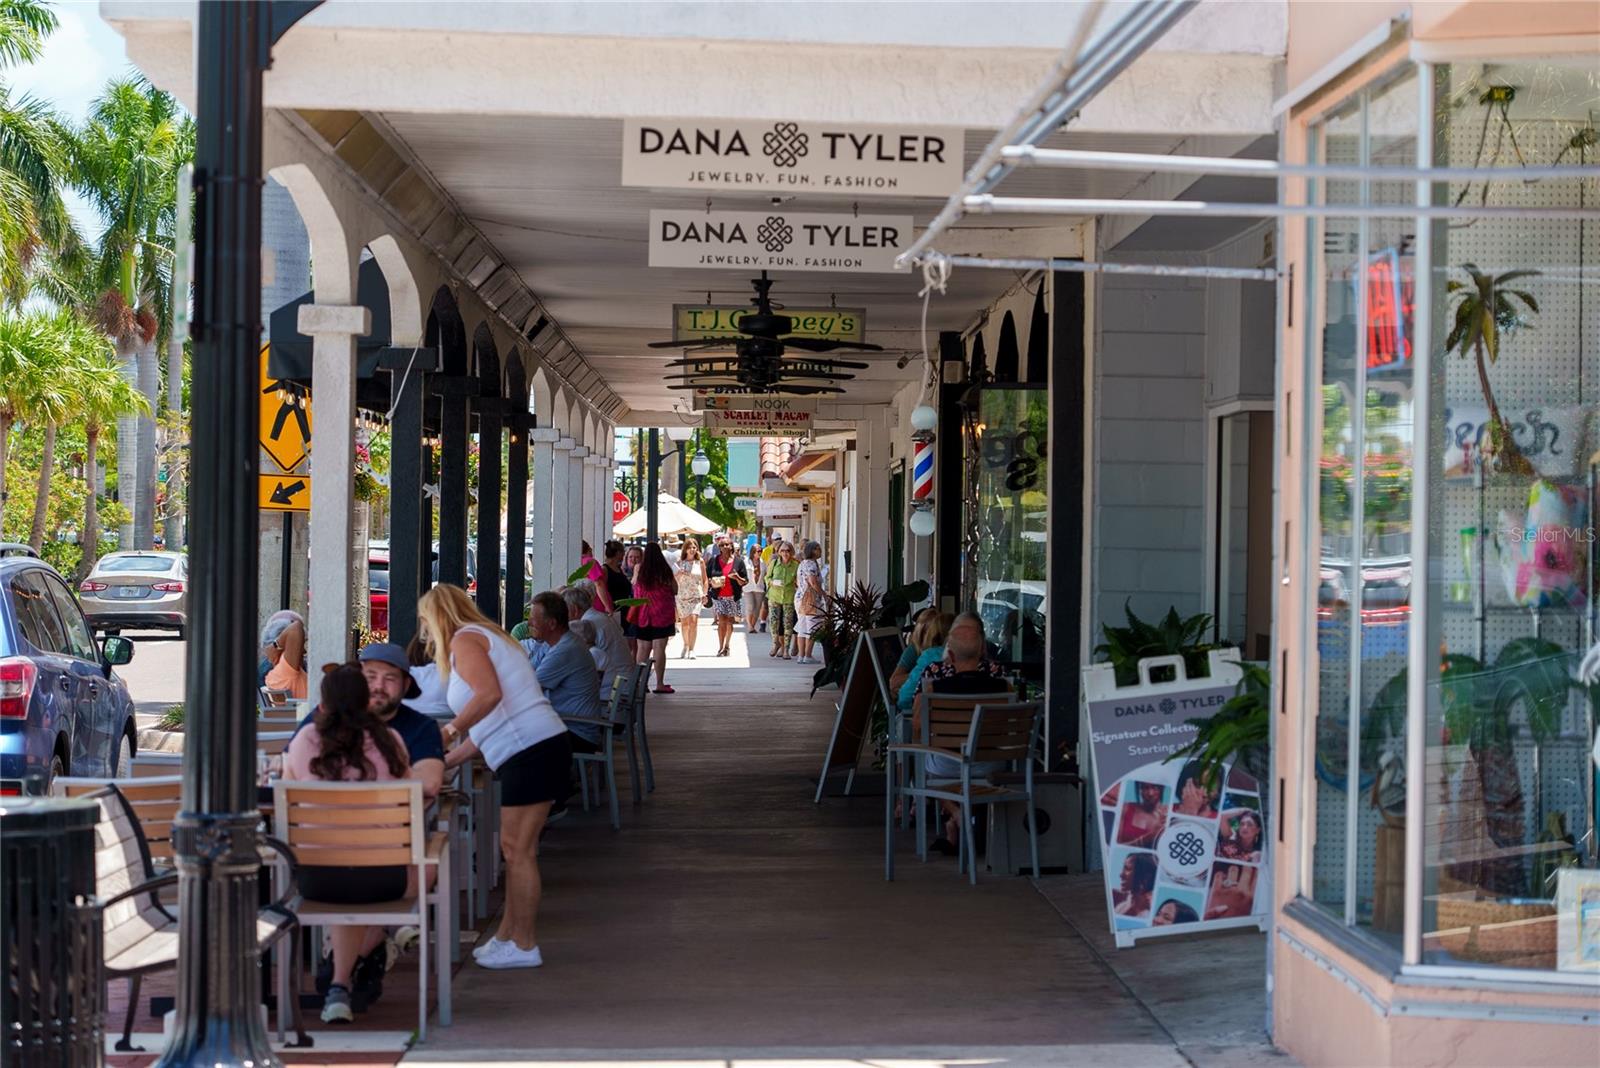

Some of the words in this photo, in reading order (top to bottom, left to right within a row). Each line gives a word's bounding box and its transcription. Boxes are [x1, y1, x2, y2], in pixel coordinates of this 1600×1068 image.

[640, 127, 750, 157] DANA
[822, 132, 946, 163] TYLER
[688, 171, 770, 184] JEWELRY.
[778, 173, 816, 185] FUN.
[824, 175, 898, 188] FASHION
[661, 221, 748, 244] DANA
[803, 225, 899, 248] TYLER
[699, 255, 763, 266] JEWELRY.
[769, 256, 798, 267] FUN.
[805, 257, 863, 268] FASHION
[754, 399, 791, 410] NOOK
[723, 410, 768, 420] SCARLET
[775, 411, 811, 421] MACAW
[783, 429, 806, 437] Shop
[613, 500, 628, 513] OP
[1114, 703, 1156, 718] DANA
[1180, 695, 1226, 710] TYLER
[1092, 729, 1147, 745] Signature
[1127, 741, 1177, 756] Starting
